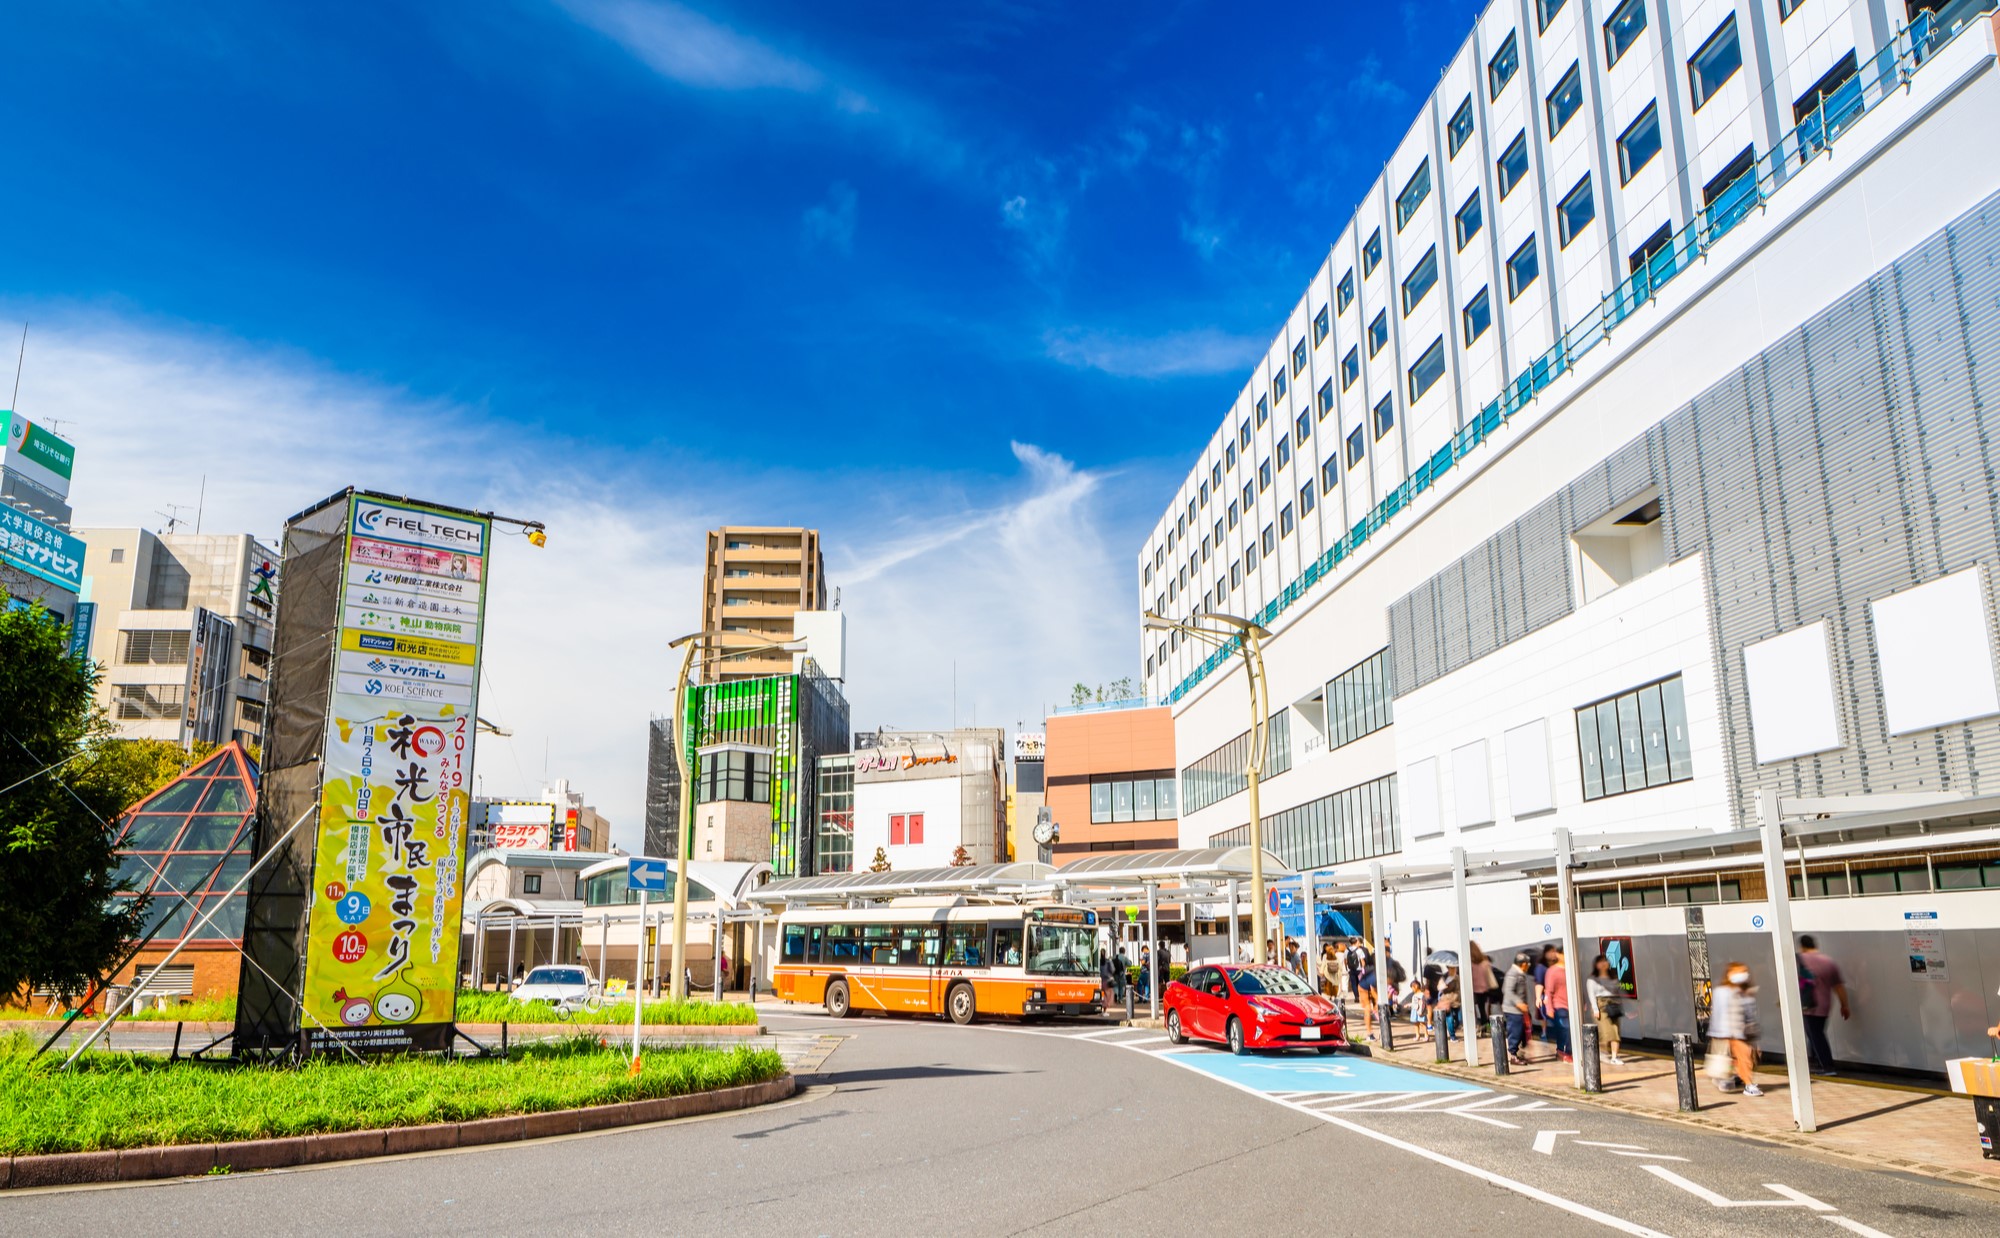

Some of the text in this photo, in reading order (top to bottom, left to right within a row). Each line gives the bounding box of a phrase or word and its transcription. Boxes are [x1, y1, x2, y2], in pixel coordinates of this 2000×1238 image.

[33, 437, 71, 467] 埼玉りそな銀行
[2, 510, 63, 551] 大学現役合格
[395, 597, 462, 615] 新倉造園土木
[399, 616, 422, 630] 神山
[425, 619, 462, 634] 動物病院
[396, 642, 427, 655] 和光店
[388, 664, 446, 680] マックホーム
[384, 684, 405, 694] KOEI
[406, 687, 444, 698] SCIENCE
[419, 736, 441, 746] WAKO
[452, 717, 467, 788] 2019
[435, 757, 450, 838] みんなでつくる
[495, 825, 541, 837] カラオケ
[496, 838, 528, 849] マック
